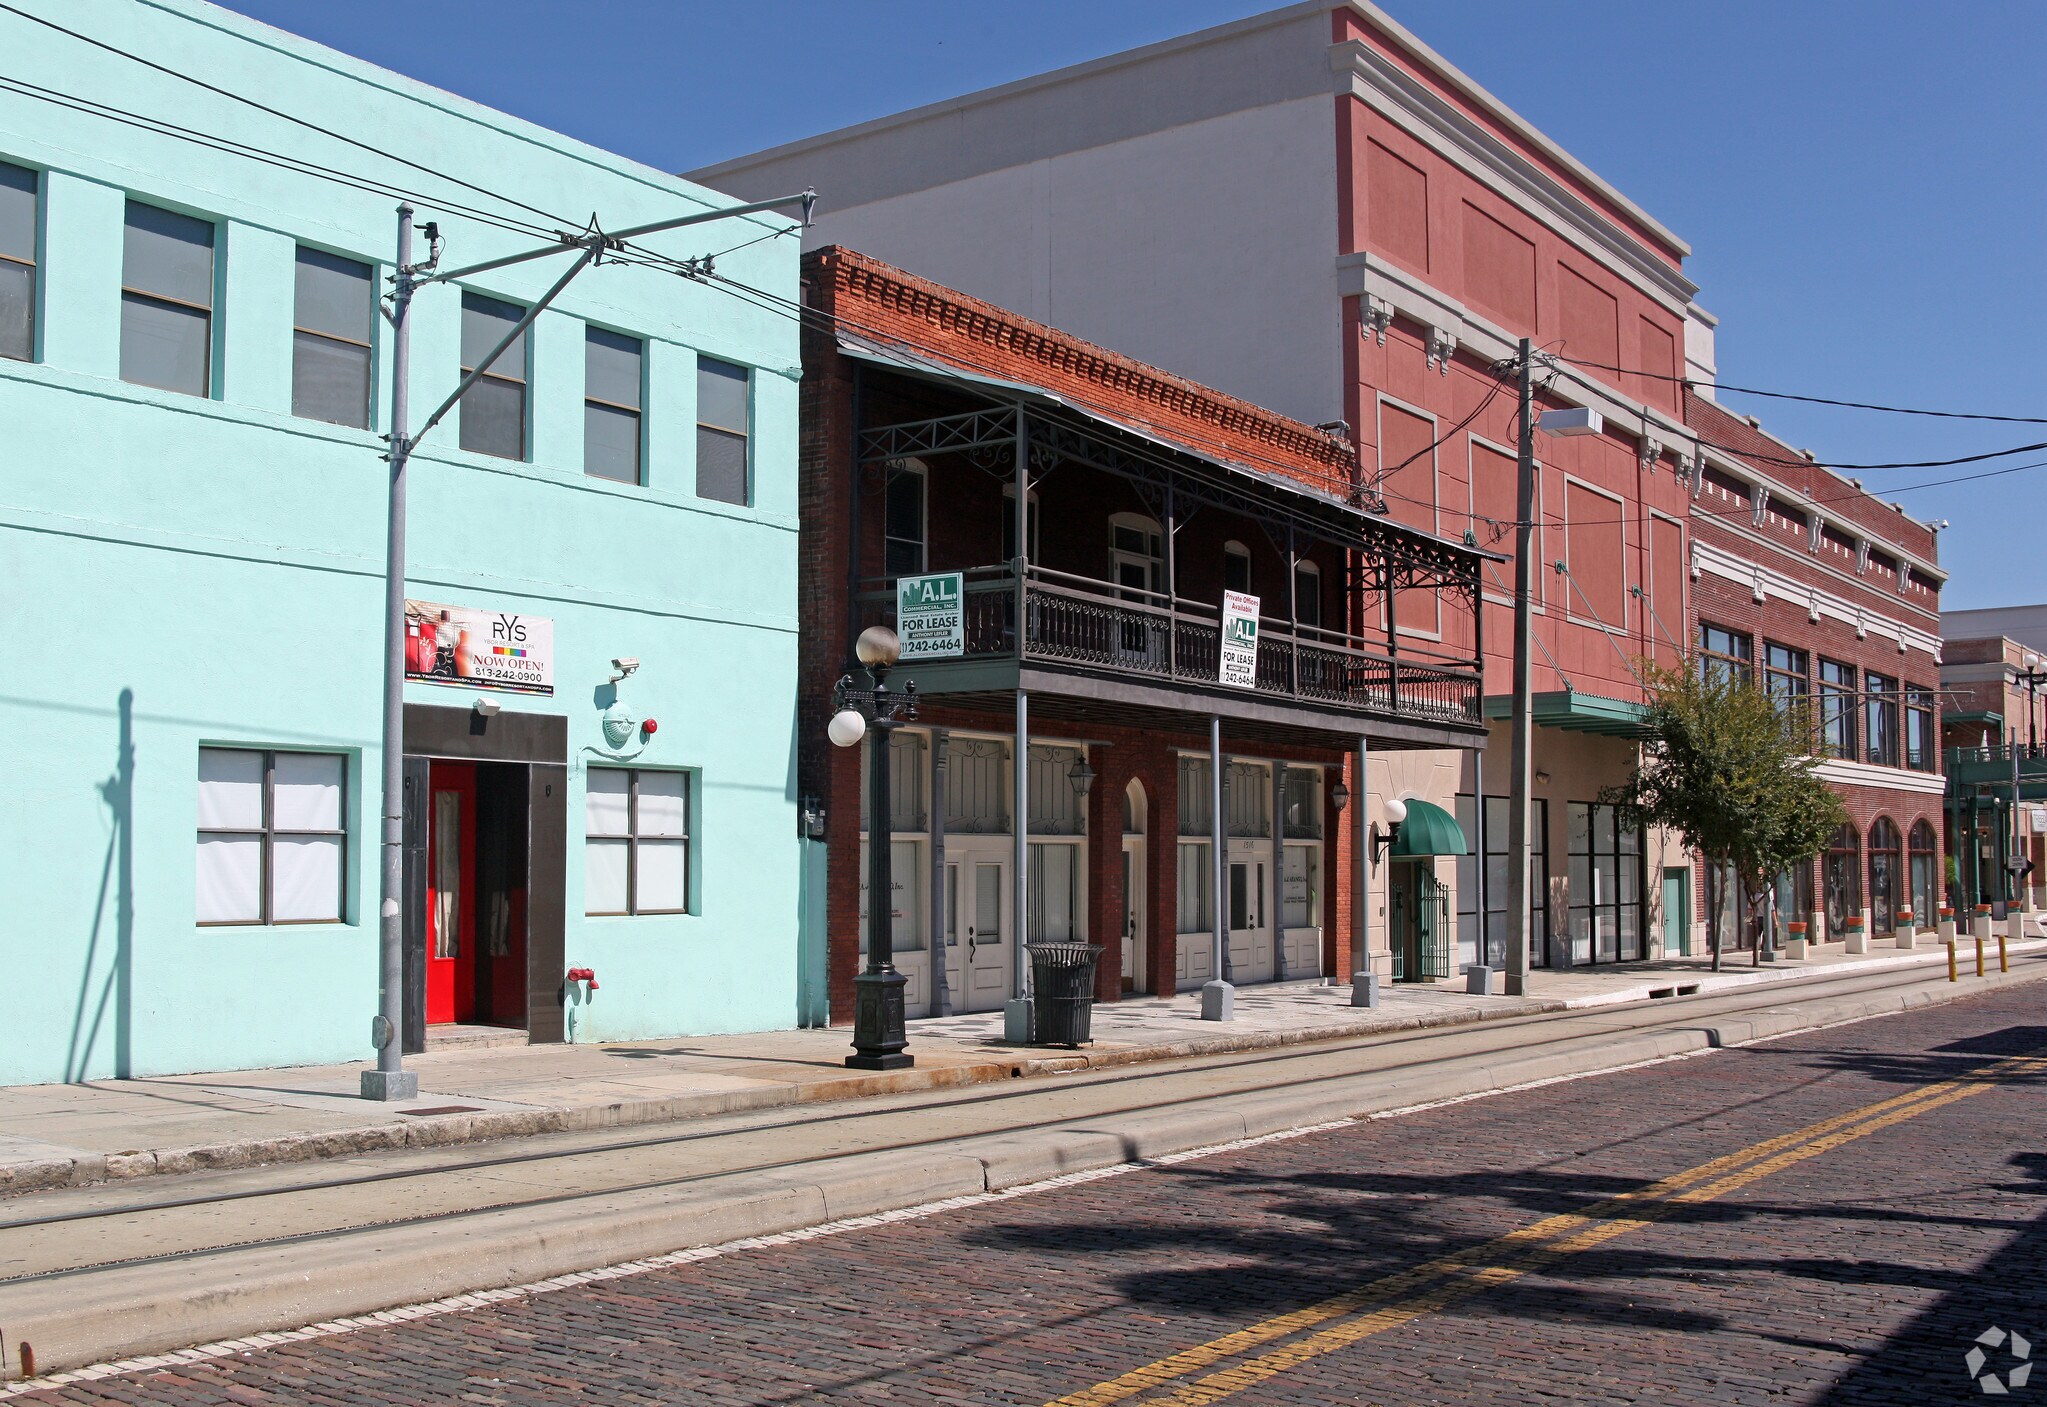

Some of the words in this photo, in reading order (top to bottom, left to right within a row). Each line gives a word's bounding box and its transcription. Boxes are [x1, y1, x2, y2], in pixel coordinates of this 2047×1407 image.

[921, 580, 957, 602] A.L.
[1226, 593, 1242, 602] Private
[1243, 596, 1259, 607] Offices
[1232, 603, 1252, 614] Available
[492, 614, 527, 642] RYS
[902, 619, 923, 631] FOR
[926, 616, 958, 628] LEASE
[1235, 621, 1254, 641] A.L.
[473, 655, 506, 667] NOW
[508, 659, 544, 671] OPEN!
[1224, 652, 1235, 662] FOR
[1237, 654, 1254, 665] LEASE
[475, 667, 542, 682] 813-242-0900
